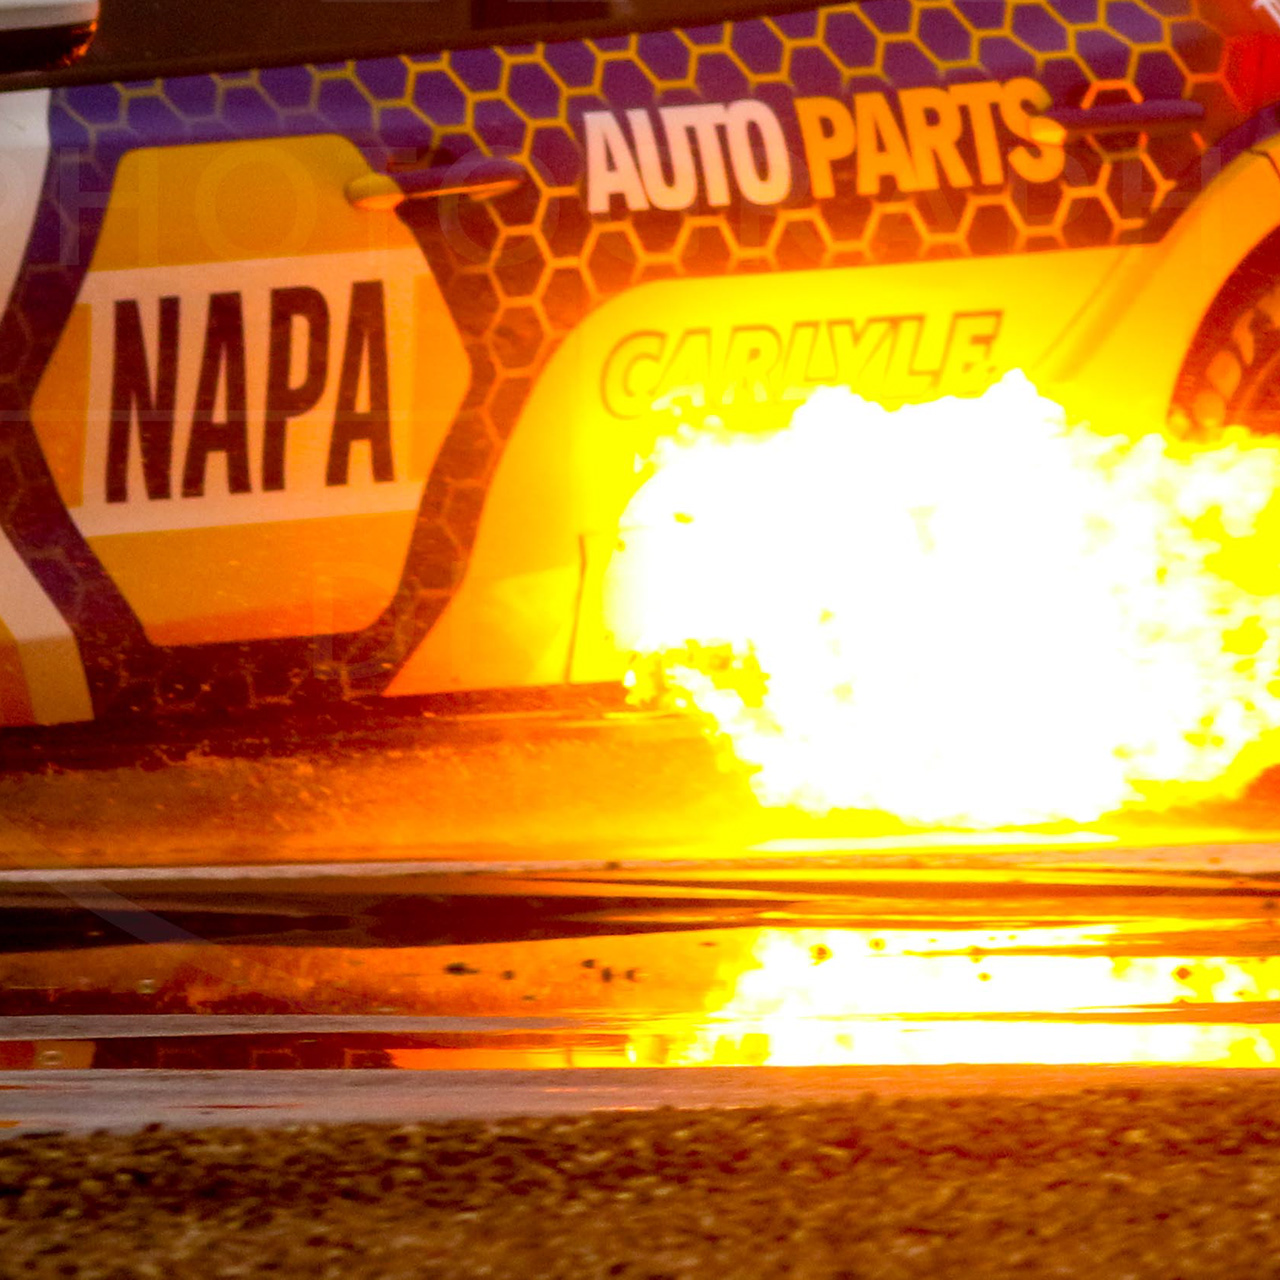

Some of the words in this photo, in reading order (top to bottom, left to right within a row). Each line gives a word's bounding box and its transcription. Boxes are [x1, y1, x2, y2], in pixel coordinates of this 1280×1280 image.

[582, 99, 791, 215] AUTO
[793, 77, 1066, 200] PARTS
[105, 280, 395, 504] NAPA
[600, 308, 1004, 420] CARLYLE
